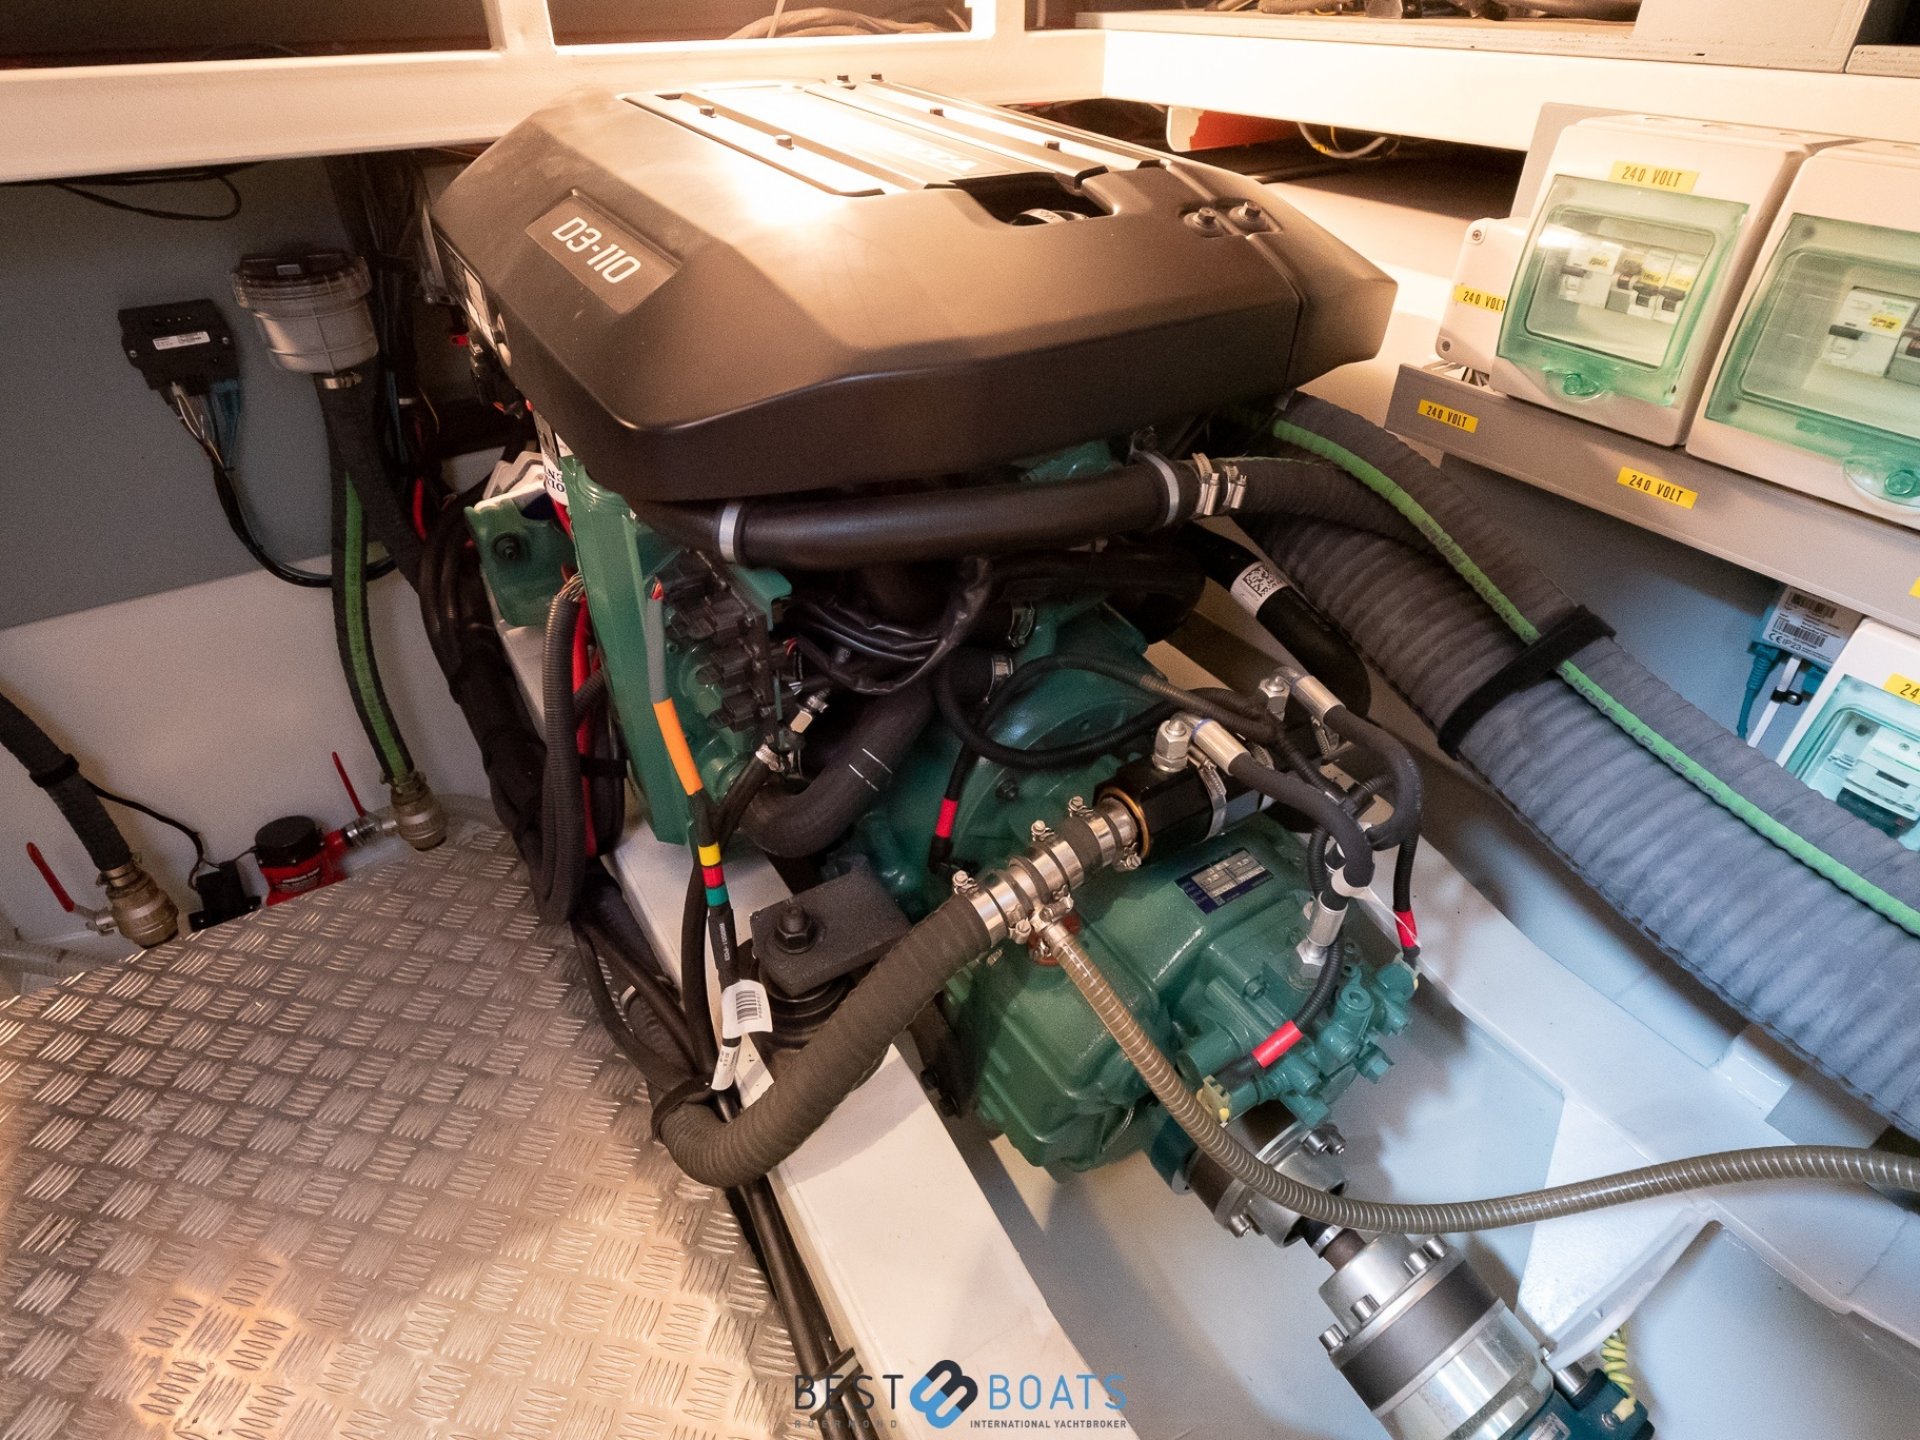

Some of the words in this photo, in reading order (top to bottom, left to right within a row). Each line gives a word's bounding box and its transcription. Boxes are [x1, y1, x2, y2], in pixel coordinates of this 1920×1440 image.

[1621, 166, 1646, 182] 240
[1652, 168, 1682, 187] VOLT
[552, 216, 642, 284] D3-110
[1463, 291, 1481, 305] 240
[1485, 295, 1506, 312] VOLT
[1427, 405, 1444, 419] 240
[1447, 411, 1468, 428] VOLT
[1629, 474, 1651, 491] 240
[1657, 483, 1684, 502] VOLT
[1900, 683, 1920, 702] 24
